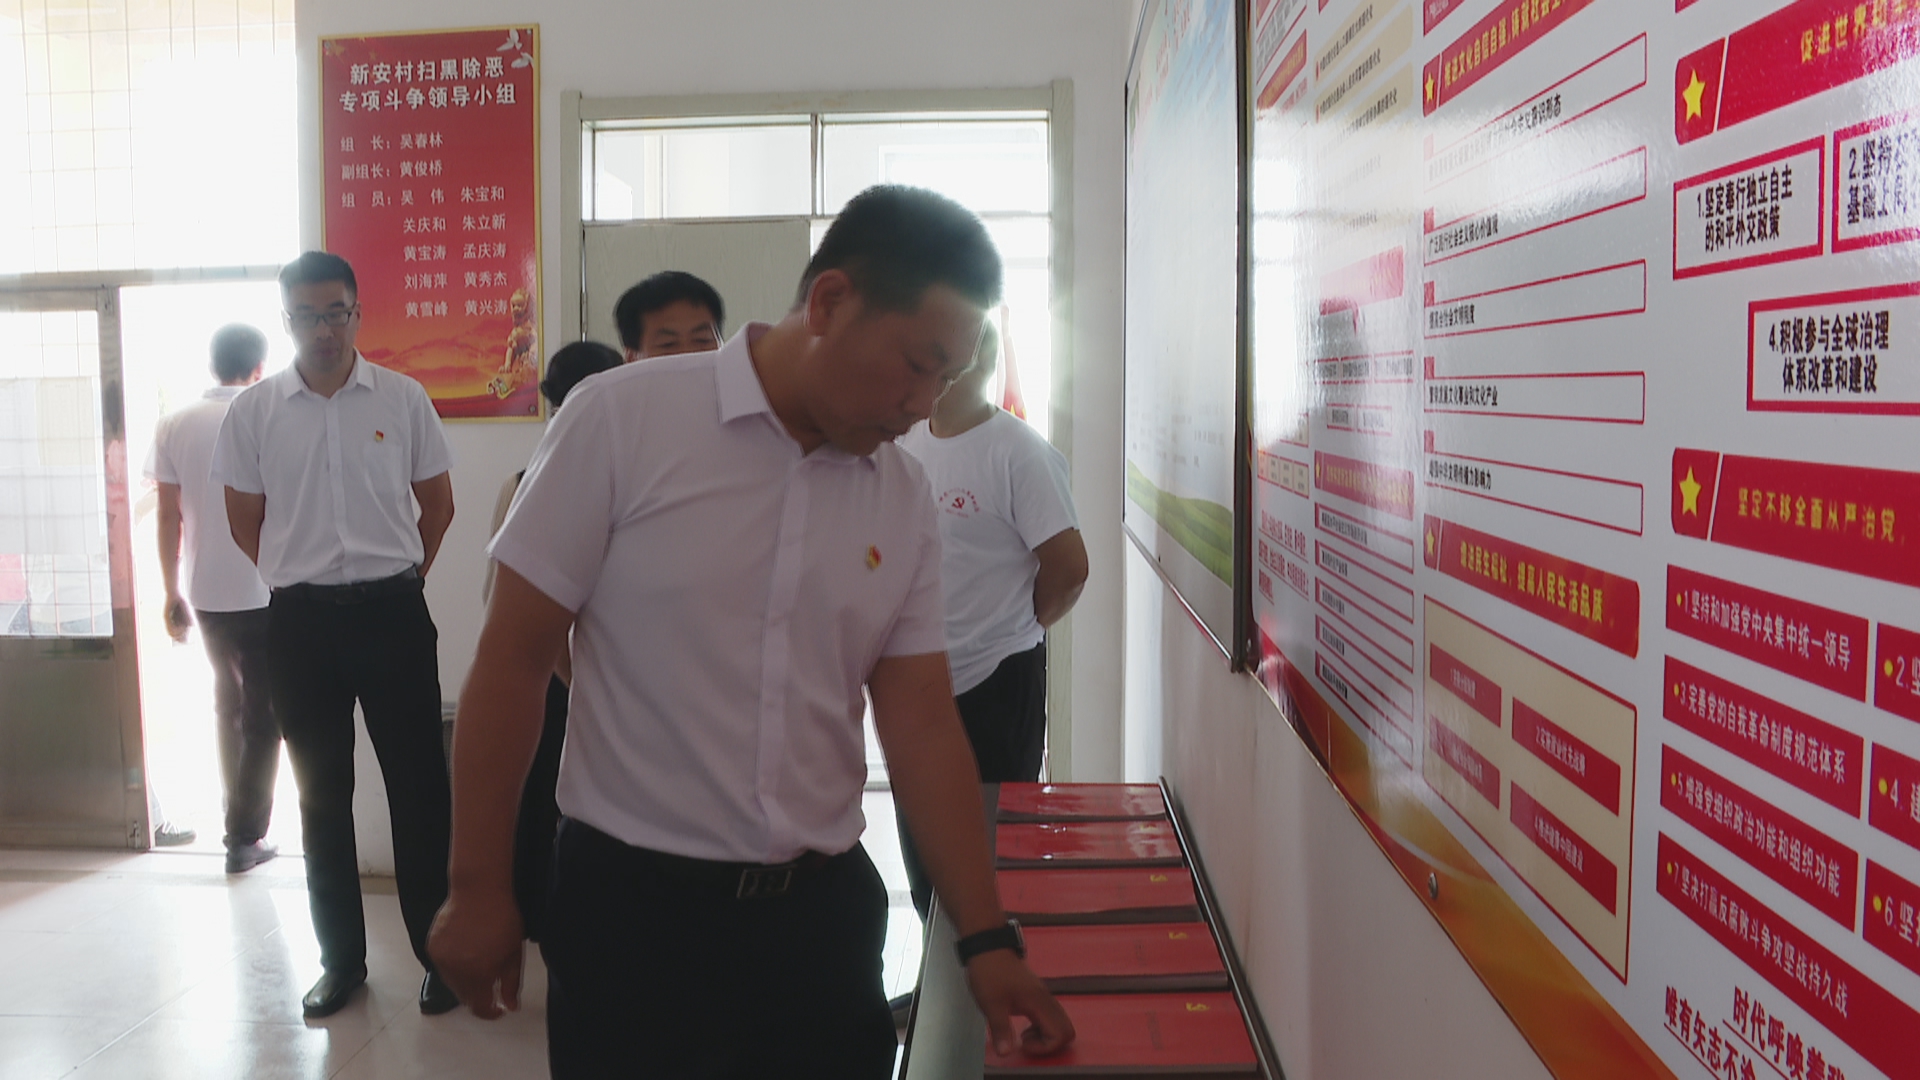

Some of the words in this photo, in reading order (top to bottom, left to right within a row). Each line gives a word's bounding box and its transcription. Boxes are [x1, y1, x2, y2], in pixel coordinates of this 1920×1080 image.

[350, 56, 504, 85] 新安村扫黑除恶
[339, 83, 516, 112] 专项斗争领导小组
[461, 186, 505, 203] 朱宝和
[1697, 163, 1792, 218] 1.坚定奉行独立自主
[403, 217, 446, 233] 关庆和
[463, 213, 506, 231] 朱立新
[1705, 204, 1780, 252] 的和平外交政策
[404, 245, 446, 262] 黄宝涛
[463, 242, 506, 259] 孟庆涛
[404, 272, 447, 289] 刘海萍
[464, 271, 507, 288] 黄秀杰
[406, 301, 448, 318] 黄雪峰
[465, 299, 508, 316] 黄兴涛
[1769, 310, 1890, 353] 4.积极参与全球治理
[1783, 354, 1878, 393] 体系改革和建设
[1884, 895, 1920, 947] 6.坚
